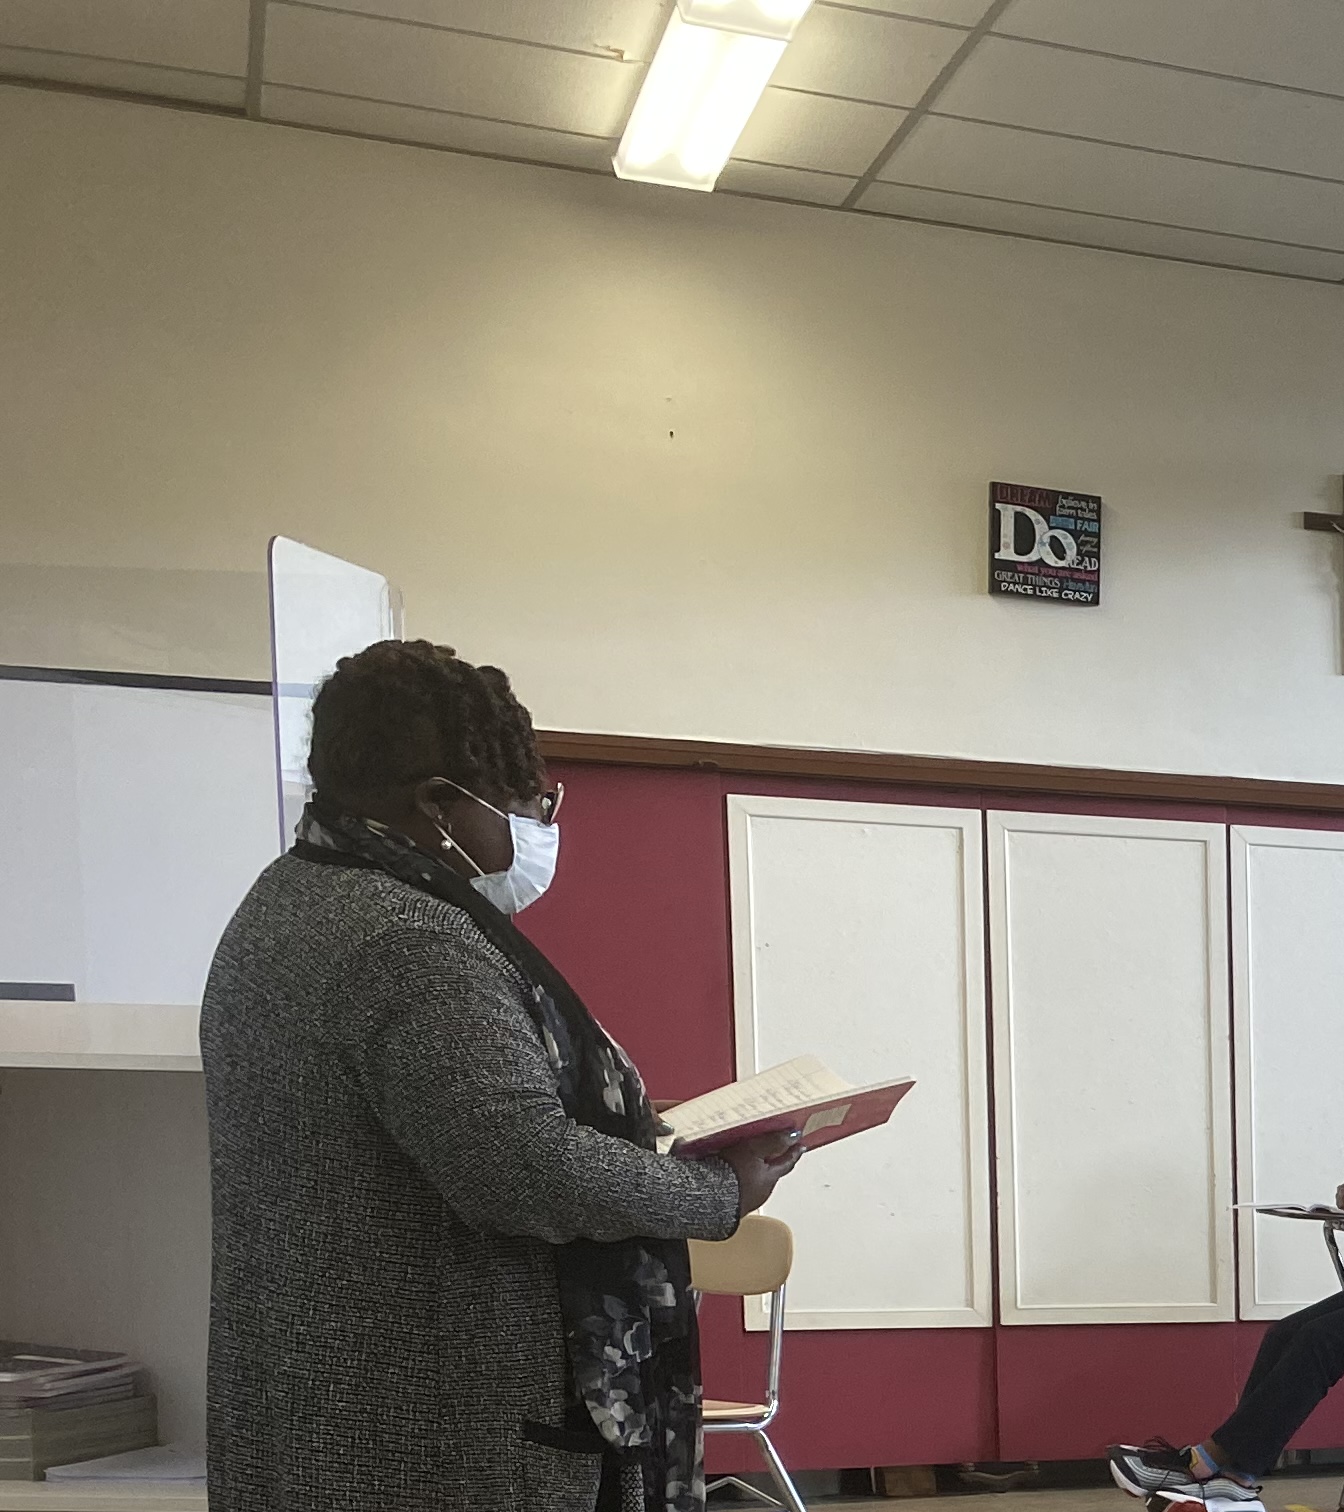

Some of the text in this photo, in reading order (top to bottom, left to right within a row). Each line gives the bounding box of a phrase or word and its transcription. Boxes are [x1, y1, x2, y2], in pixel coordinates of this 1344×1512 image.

[1077, 519, 1098, 532] FAIR
[995, 503, 1077, 566] Do
[995, 570, 1060, 587] GREAT THINGS
[1016, 564, 1038, 576] what
[1041, 568, 1059, 577] you
[1058, 570, 1072, 578] are
[1001, 583, 1093, 602] DANCE LIKE CRAZY
